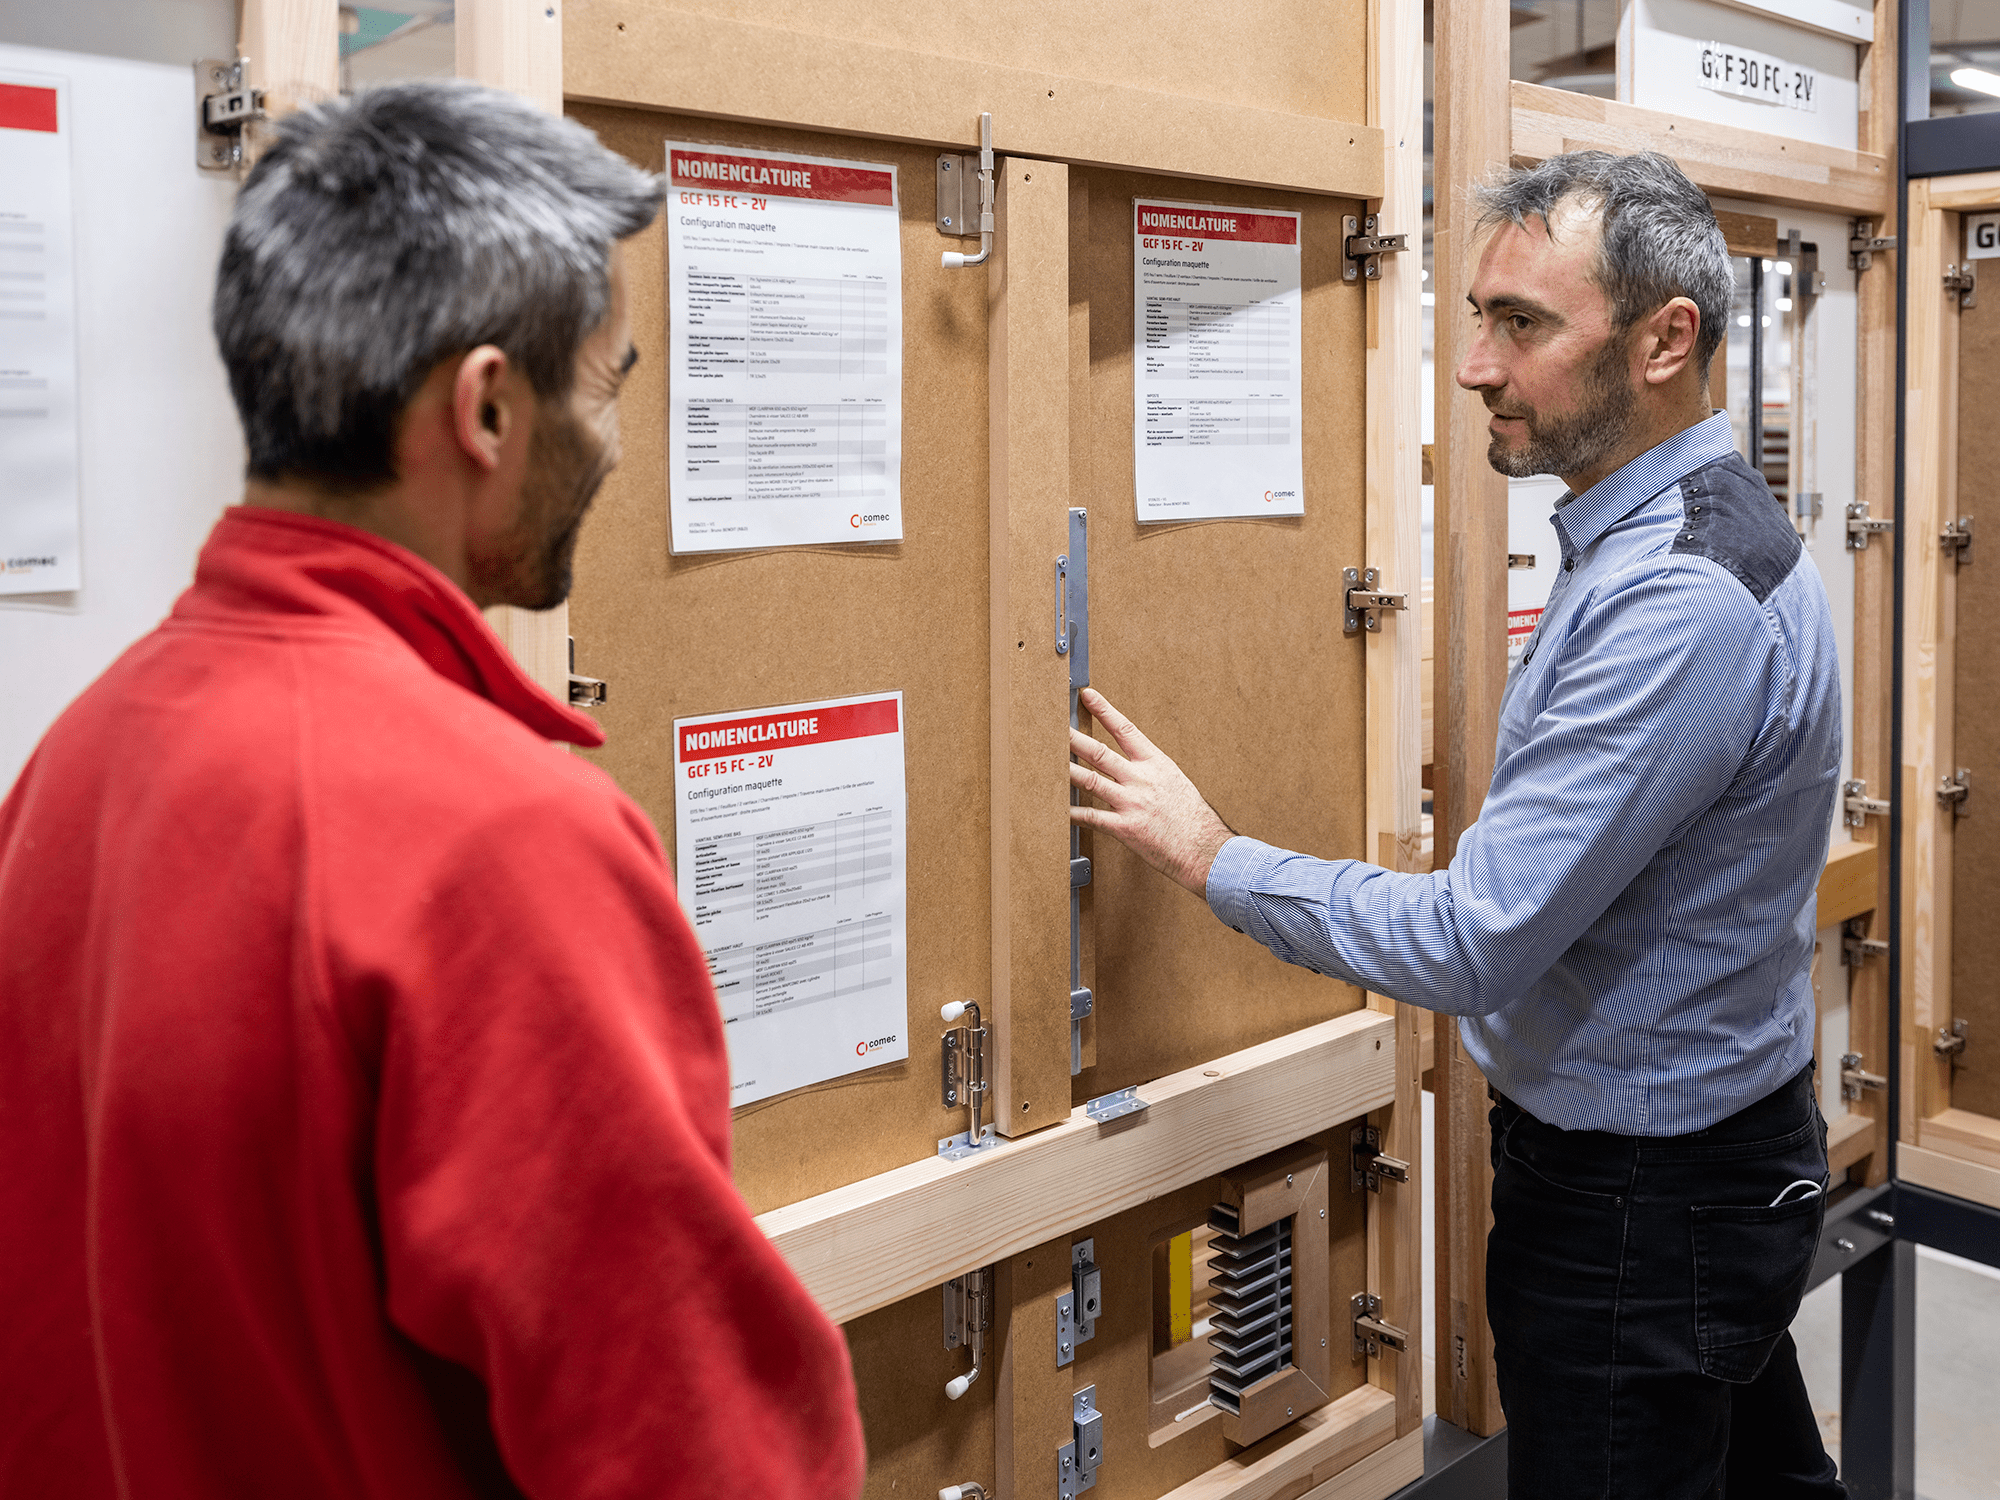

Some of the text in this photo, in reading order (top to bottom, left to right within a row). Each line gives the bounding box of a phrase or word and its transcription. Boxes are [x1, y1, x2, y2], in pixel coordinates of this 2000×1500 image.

[1739, 58, 1758, 88] 30
[1764, 64, 1780, 94] FC
[1795, 72, 1813, 101] 2V
[677, 158, 812, 188] NOMENCLATURE
[680, 192, 703, 206] GCF
[707, 194, 720, 206] 15
[724, 196, 738, 208] FC
[752, 198, 767, 211] 2V
[680, 216, 776, 233] Configuration maquette
[1142, 212, 1236, 232] NOMENCLATURE
[1143, 238, 1159, 249] GCF
[1161, 239, 1170, 250] 15
[1173, 240, 1182, 250] FC
[1192, 241, 1203, 252] 2V
[1976, 223, 2000, 248] G
[1143, 257, 1210, 269] Configuration maquette
[863, 514, 890, 522] comec
[1508, 614, 1542, 629] OMENCL
[1508, 637, 1513, 647] F
[686, 717, 818, 752] NOMENCLATURE
[688, 764, 710, 779] GCF
[714, 761, 727, 775] 15
[731, 759, 745, 772] FC
[758, 754, 774, 769] 2V
[688, 778, 782, 800] Configuration maquette
[869, 1035, 896, 1048] comec
